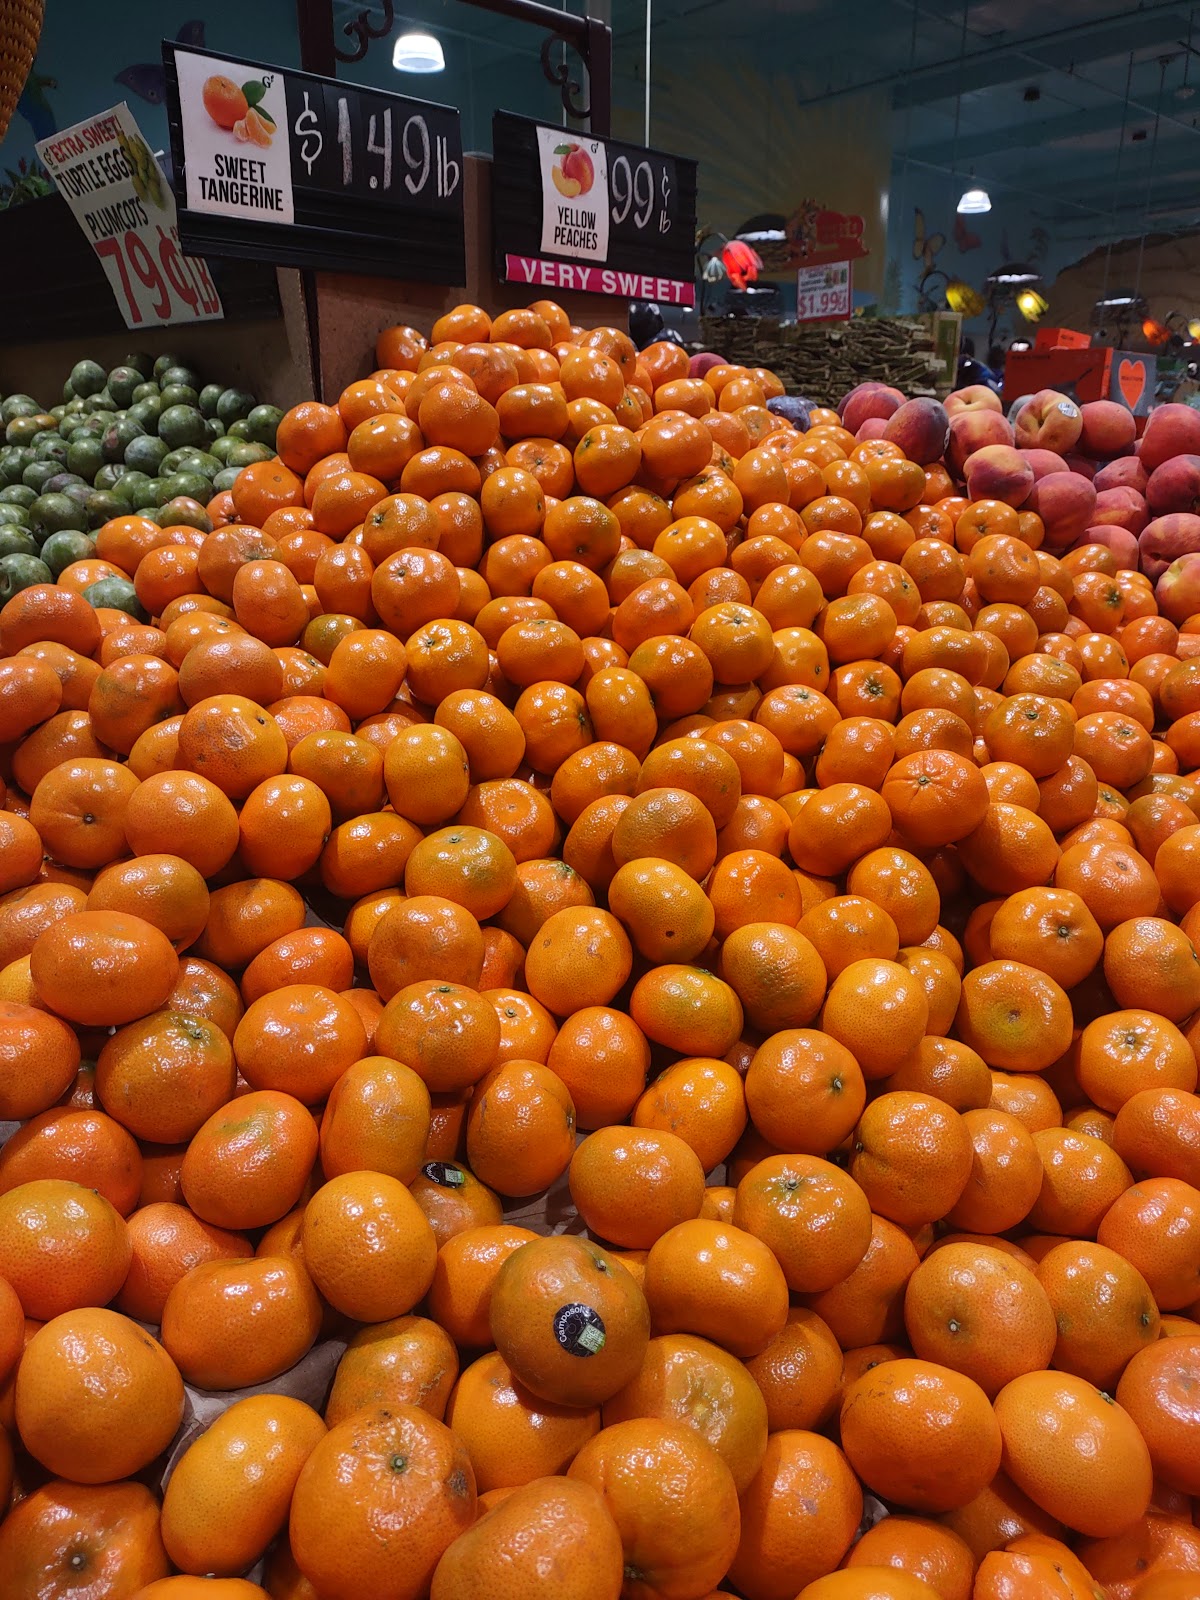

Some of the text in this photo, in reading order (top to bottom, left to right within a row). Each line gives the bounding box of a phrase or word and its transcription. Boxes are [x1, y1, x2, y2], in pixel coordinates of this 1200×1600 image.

[49, 115, 124, 164] EXTRA SWEET!
[295, 91, 460, 198] $1.49 lb
[55, 146, 135, 199] TURTLE EGGS
[214, 154, 266, 184] SWEET
[198, 177, 284, 212] TANGERINE
[85, 197, 149, 240] PLUMCOTS
[554, 226, 598, 250] PEACHES
[558, 206, 596, 230] YELLOW
[658, 210, 671, 234] lb
[94, 225, 200, 324] 79¢
[520, 258, 684, 303] VERY SWEET
